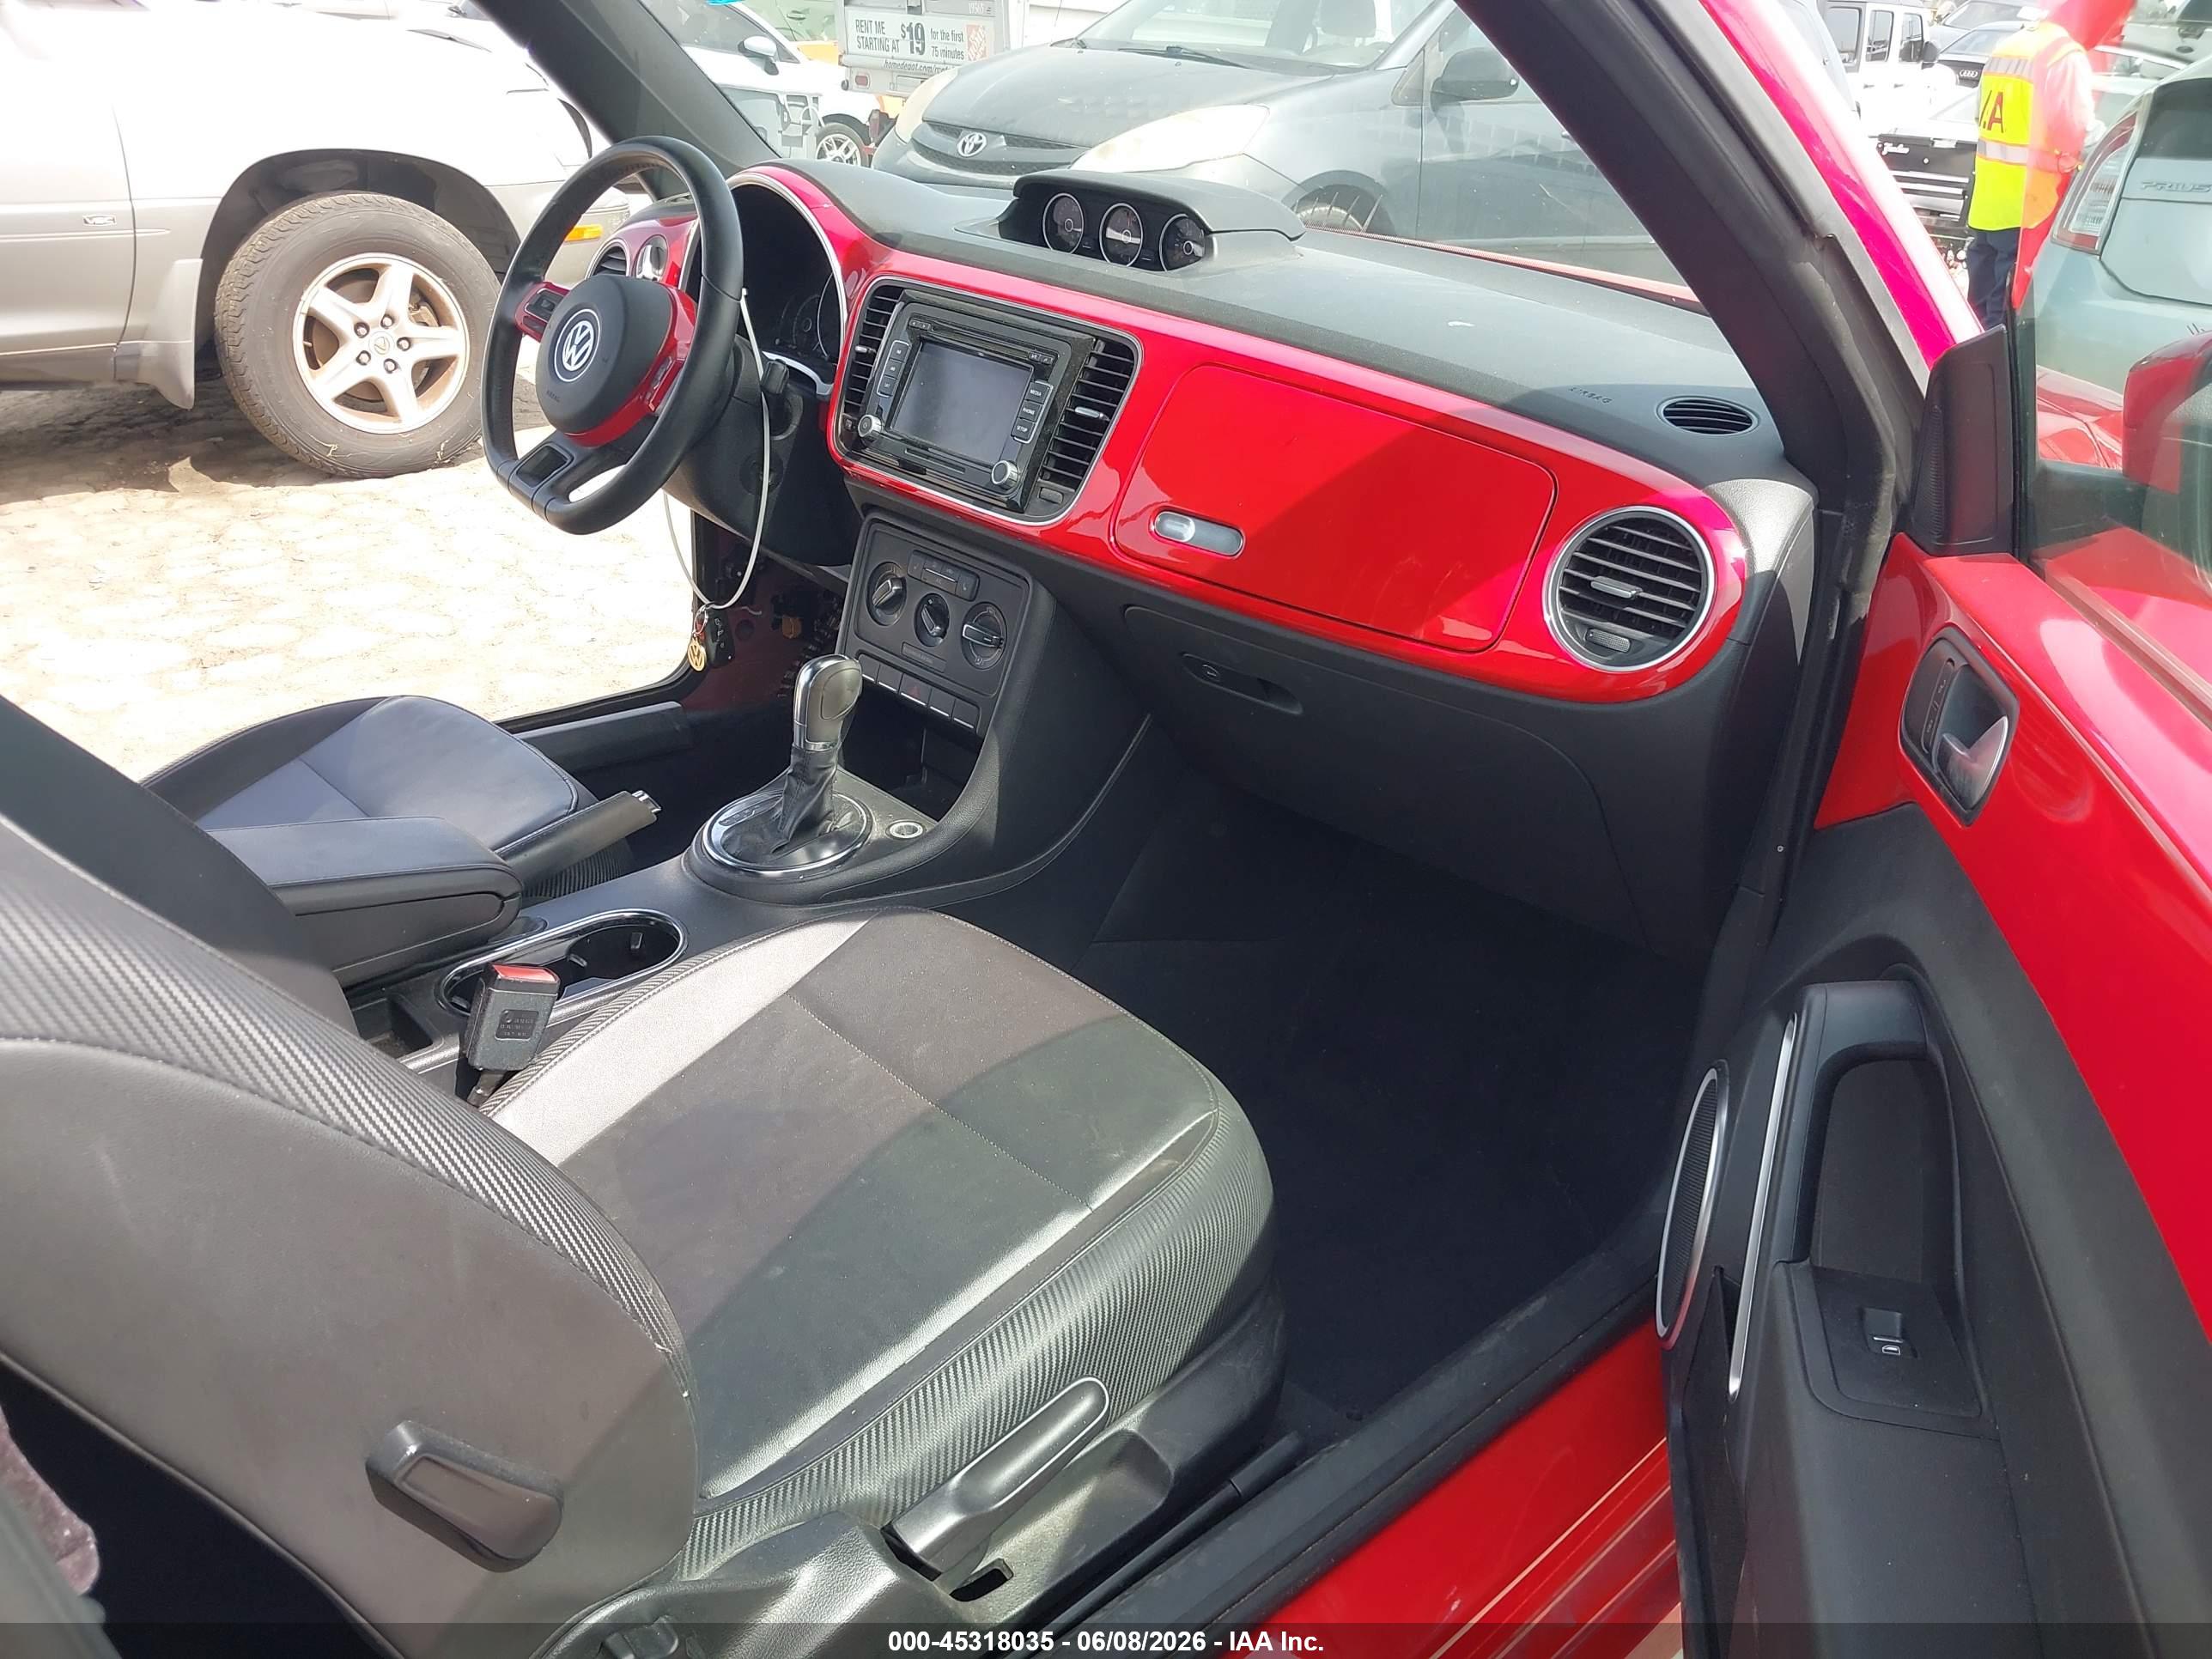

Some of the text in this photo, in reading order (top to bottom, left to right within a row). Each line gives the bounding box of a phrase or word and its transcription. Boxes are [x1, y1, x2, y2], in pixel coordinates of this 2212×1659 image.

[855, 19, 886, 35] RENT ME
[900, 21, 926, 56] $19
[930, 27, 964, 43] for the first
[857, 36, 900, 53] STARTING AT
[931, 46, 965, 60] 75 minutes
[2140, 180, 2212, 193] PRIUS
[1030, 388, 1042, 398] MEDIA
[1022, 407, 1036, 416] PHONE
